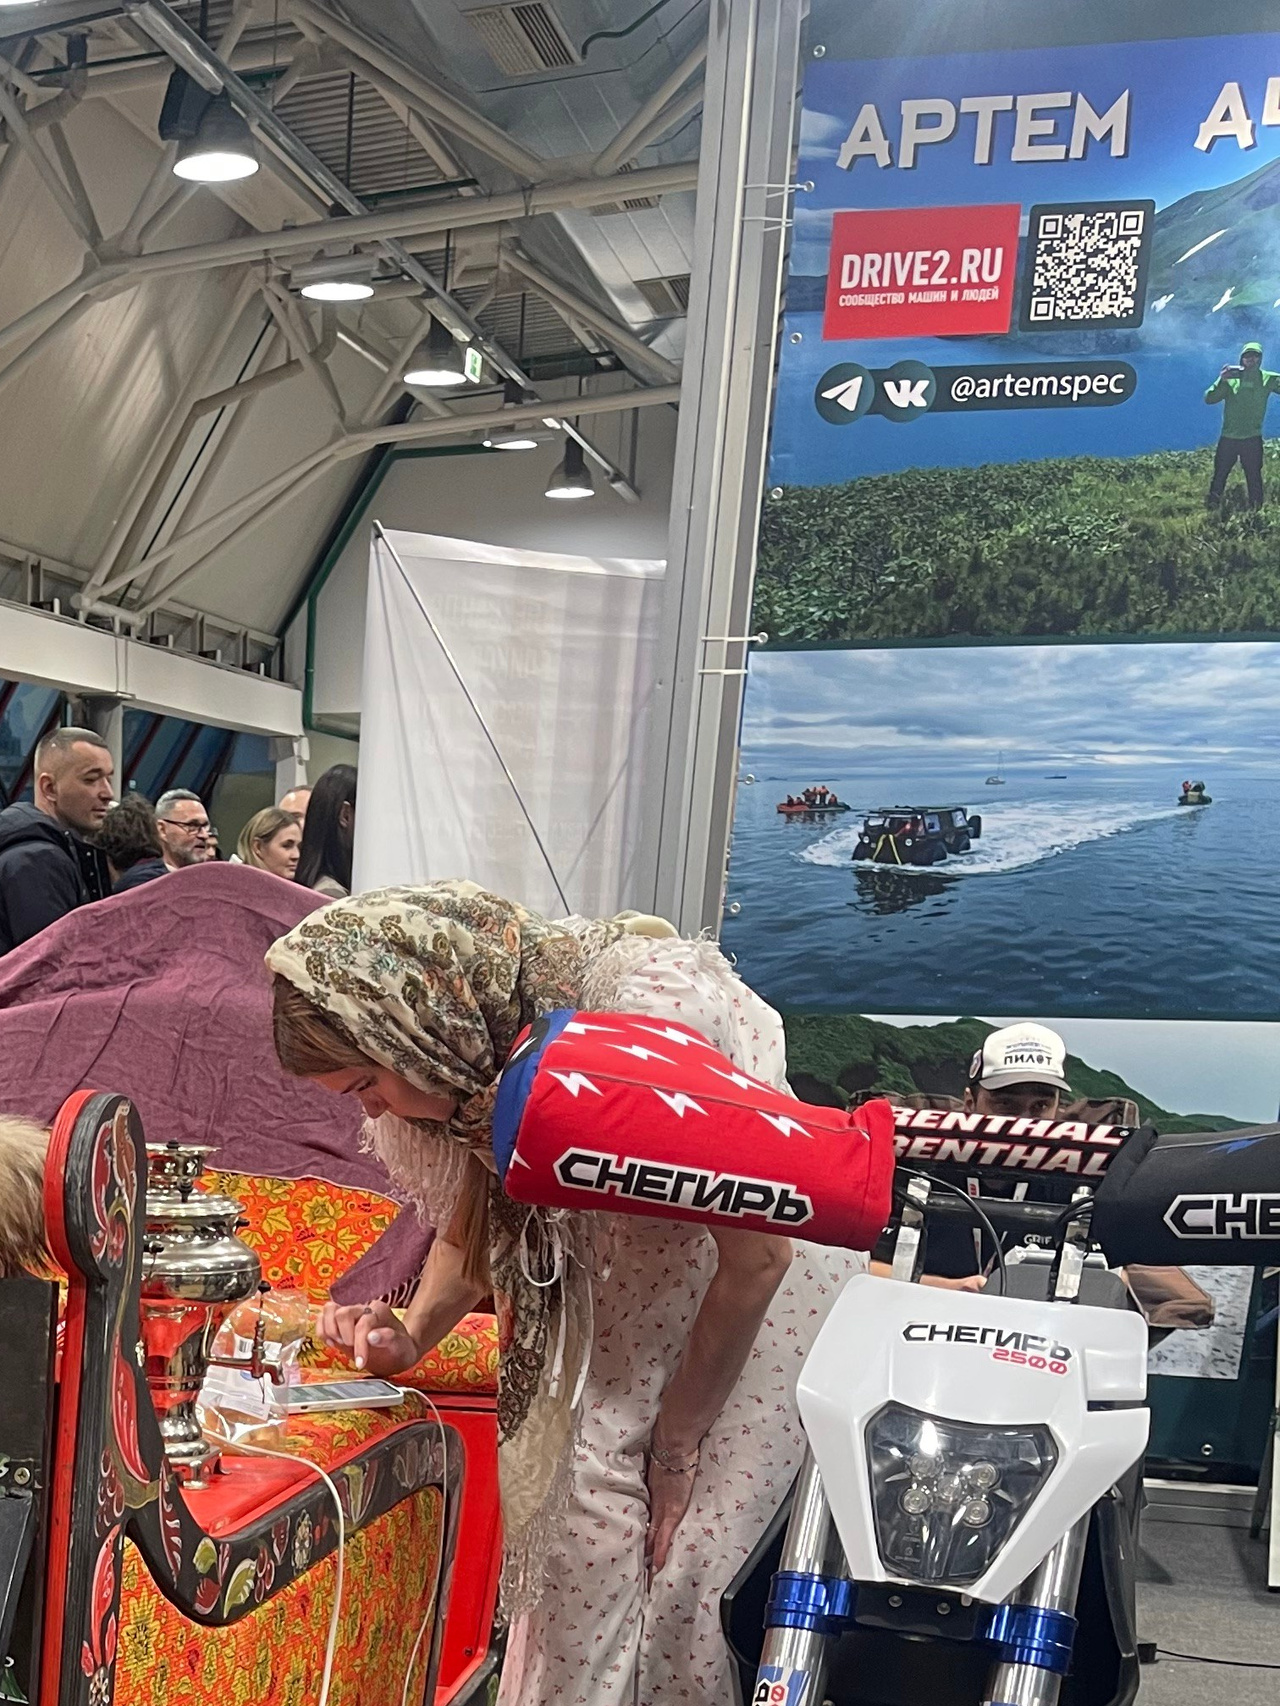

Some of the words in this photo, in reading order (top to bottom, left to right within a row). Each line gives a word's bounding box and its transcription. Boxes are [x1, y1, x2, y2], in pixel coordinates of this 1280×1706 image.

[836, 89, 1128, 170] АРТЕМ
[840, 247, 1004, 289] DRIVE2.RU
[838, 291, 905, 308] СООБЩЕСТВО
[908, 290, 947, 303] МАШИН
[950, 290, 958, 302] И
[961, 286, 999, 302] ЛЮДЕЙ
[950, 373, 1126, 402] @artemspec
[1004, 1053, 1053, 1066] ПИЛОТ
[892, 1106, 1123, 1145] RENTHAL
[556, 1150, 811, 1224] СНЕГИРЬ
[902, 1324, 1073, 1362] СНЕГИРЬ
[992, 1348, 1068, 1375] 2500
